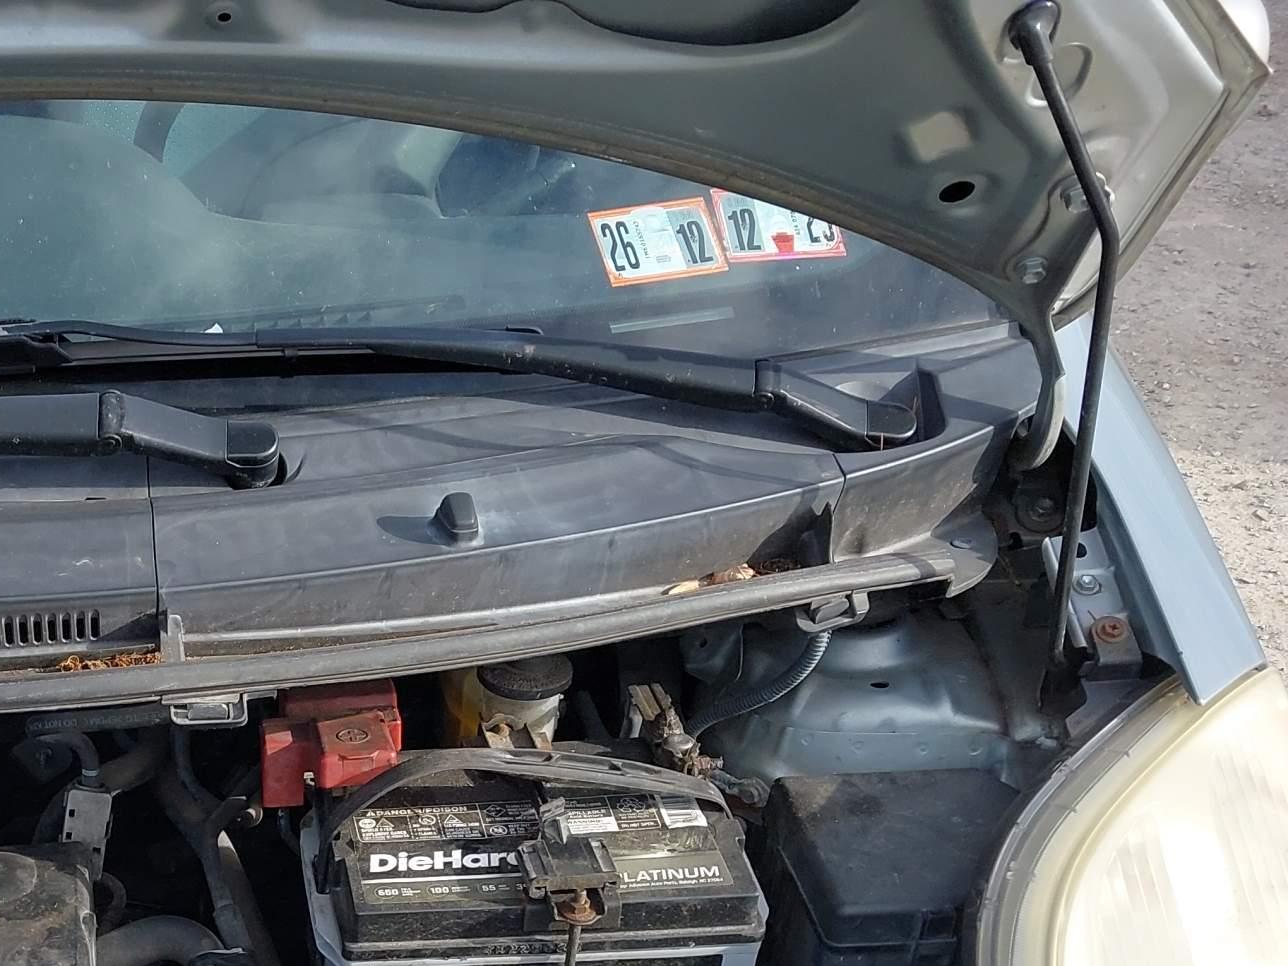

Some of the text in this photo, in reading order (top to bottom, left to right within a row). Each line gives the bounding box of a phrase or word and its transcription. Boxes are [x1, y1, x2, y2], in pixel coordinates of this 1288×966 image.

[727, 208, 762, 251] 12
[600, 220, 641, 272] 26
[675, 220, 715, 265] 12
[620, 866, 720, 883] LATINUM
[429, 886, 450, 895] 100
